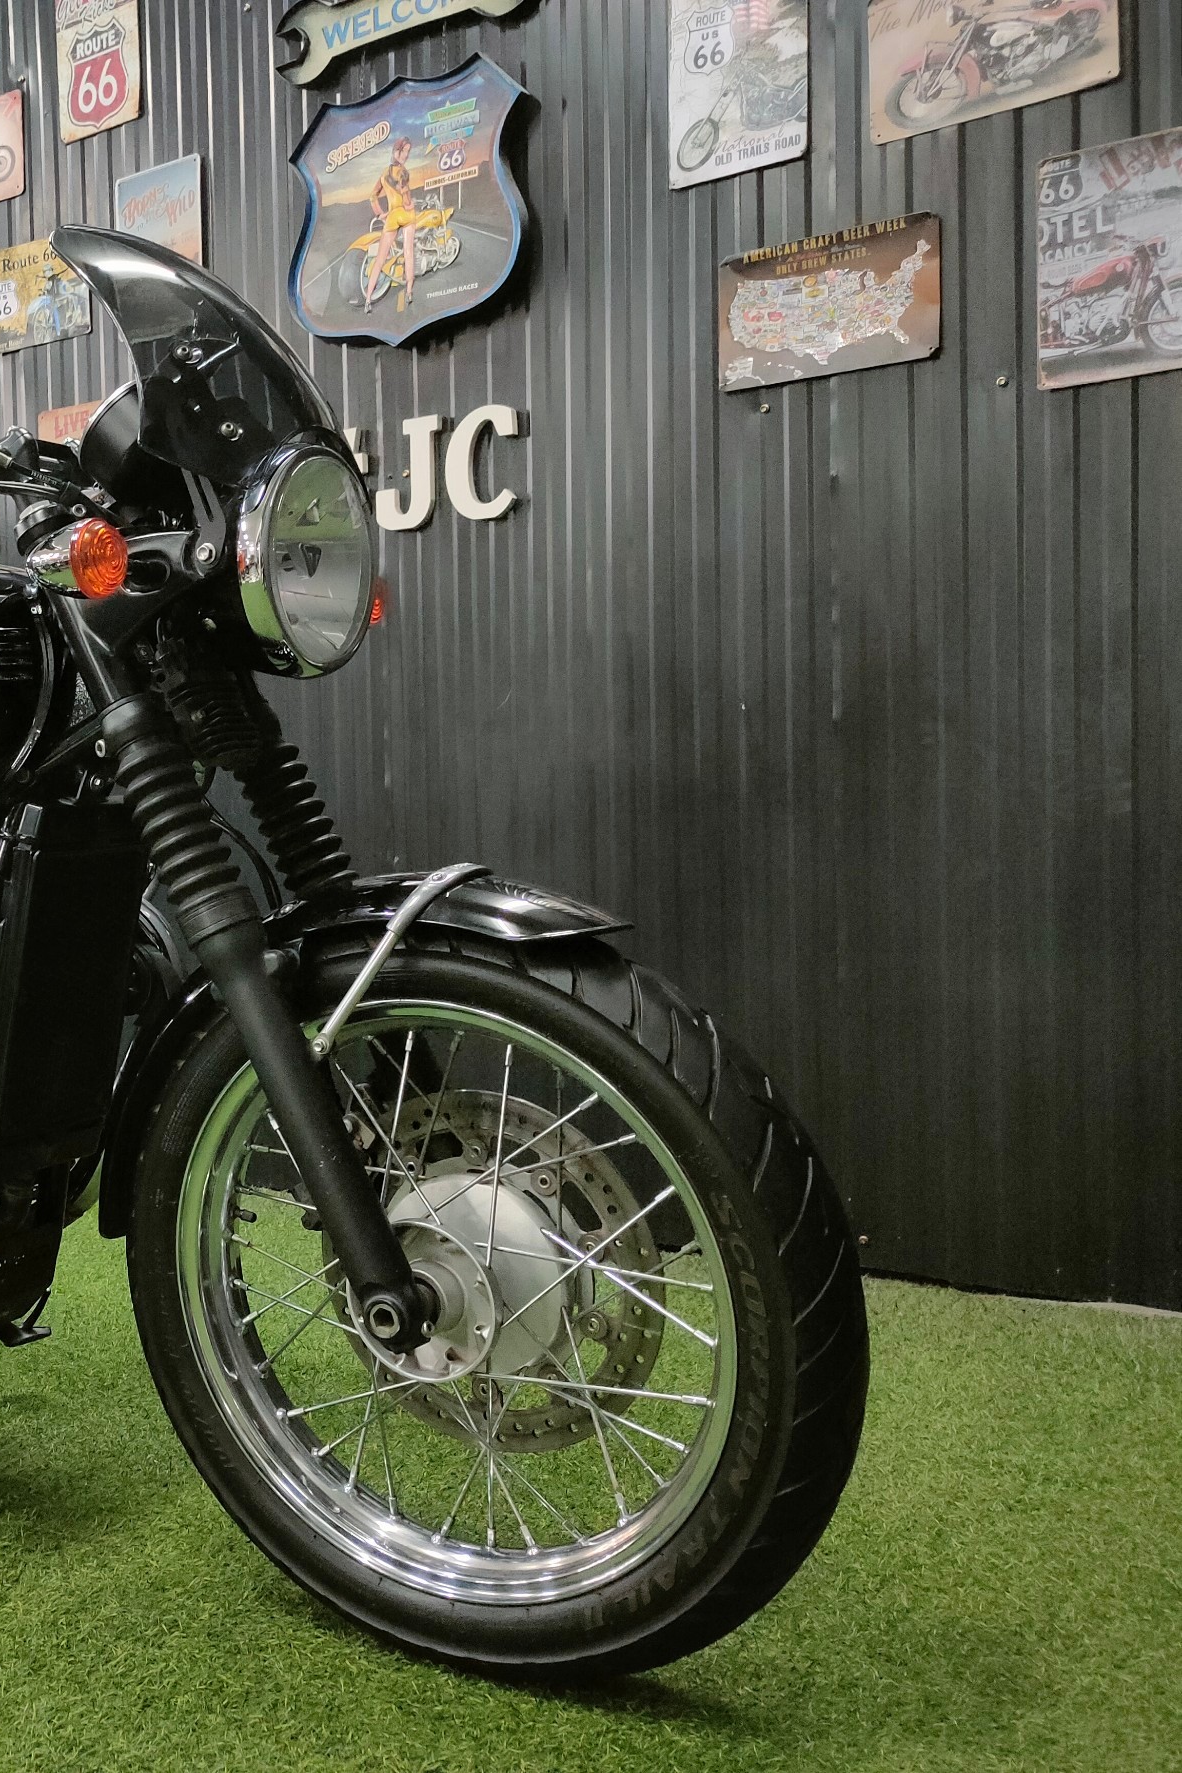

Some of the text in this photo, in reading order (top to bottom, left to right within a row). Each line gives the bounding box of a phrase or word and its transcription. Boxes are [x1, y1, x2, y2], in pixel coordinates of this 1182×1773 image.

[322, 0, 444, 49] WELCO
[696, 10, 726, 27] ROUTE
[871, 2, 900, 42] The
[76, 29, 116, 60] ROUTE
[693, 41, 725, 69] 66
[78, 58, 118, 113] 66
[714, 122, 785, 155] National
[714, 133, 801, 167] OLD TRAILS ROAD
[440, 150, 463, 171] 66
[1040, 175, 1075, 204] 66
[742, 242, 799, 265] AMERICAN
[802, 232, 838, 251] CRAFT
[842, 224, 871, 242] BEER
[875, 216, 907, 235] WEEK
[2, 252, 39, 274] Route
[43, 247, 57, 261] 66
[801, 255, 827, 271] BREW
[426, 282, 479, 299] THRILLING RACES
[343, 404, 519, 531] JC
